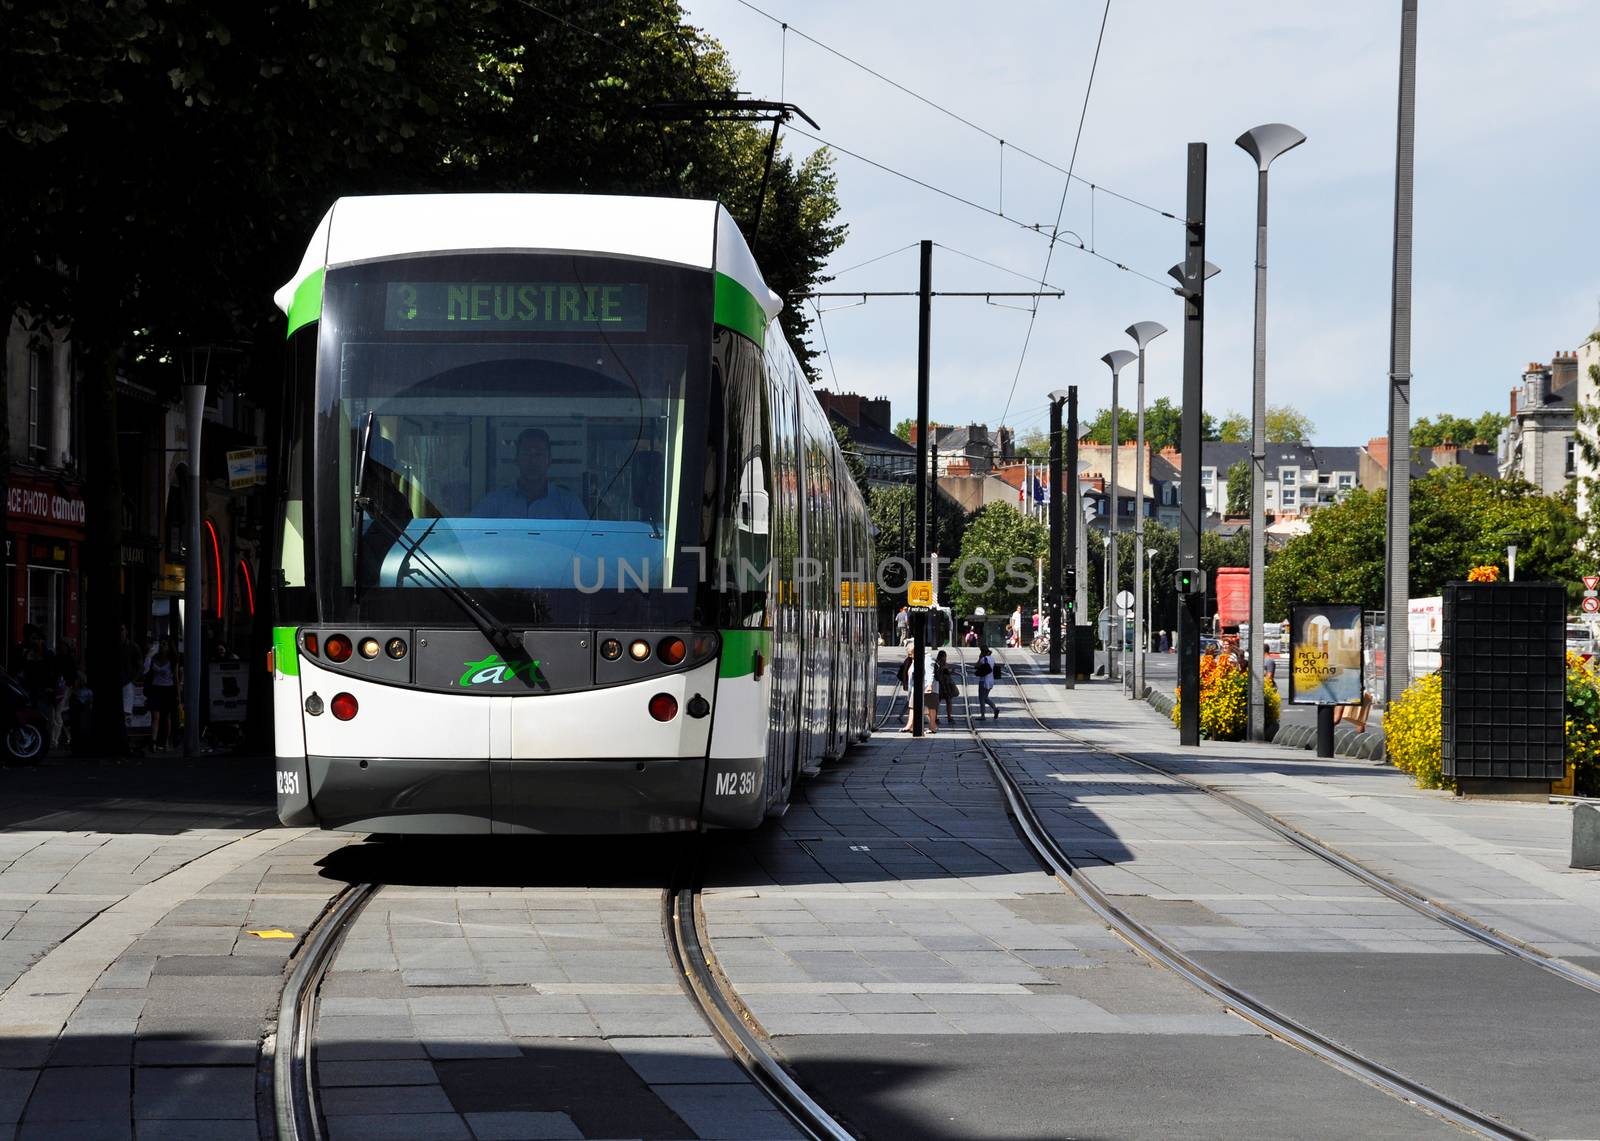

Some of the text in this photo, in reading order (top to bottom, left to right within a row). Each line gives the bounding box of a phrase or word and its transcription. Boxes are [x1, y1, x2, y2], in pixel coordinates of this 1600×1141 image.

[447, 284, 624, 322] NEUSTRIE
[23, 490, 48, 518] PHOTO
[51, 495, 86, 523] camara
[284, 771, 299, 794] 351
[715, 771, 755, 796] M2 351
